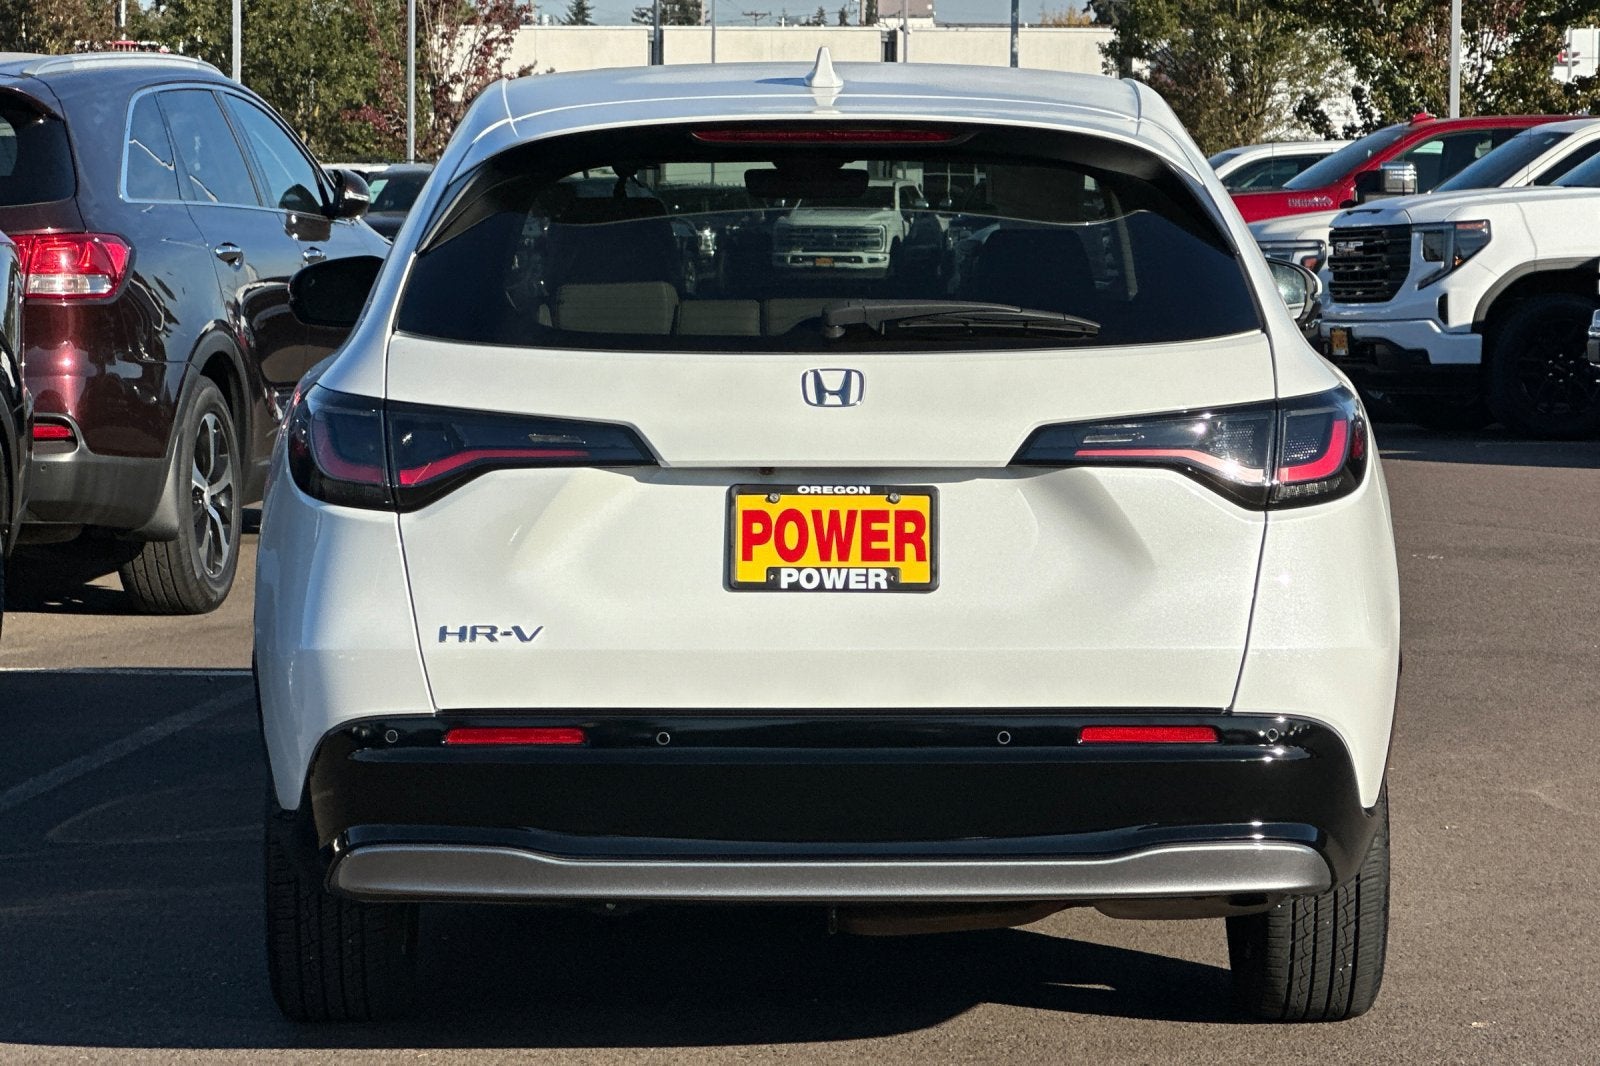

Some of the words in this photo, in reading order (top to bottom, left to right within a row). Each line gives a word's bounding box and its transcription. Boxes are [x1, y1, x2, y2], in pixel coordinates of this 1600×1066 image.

[797, 485, 871, 495] OREGON
[741, 508, 927, 563] POWER
[780, 568, 888, 590] POWER
[438, 625, 544, 643] HR-V
